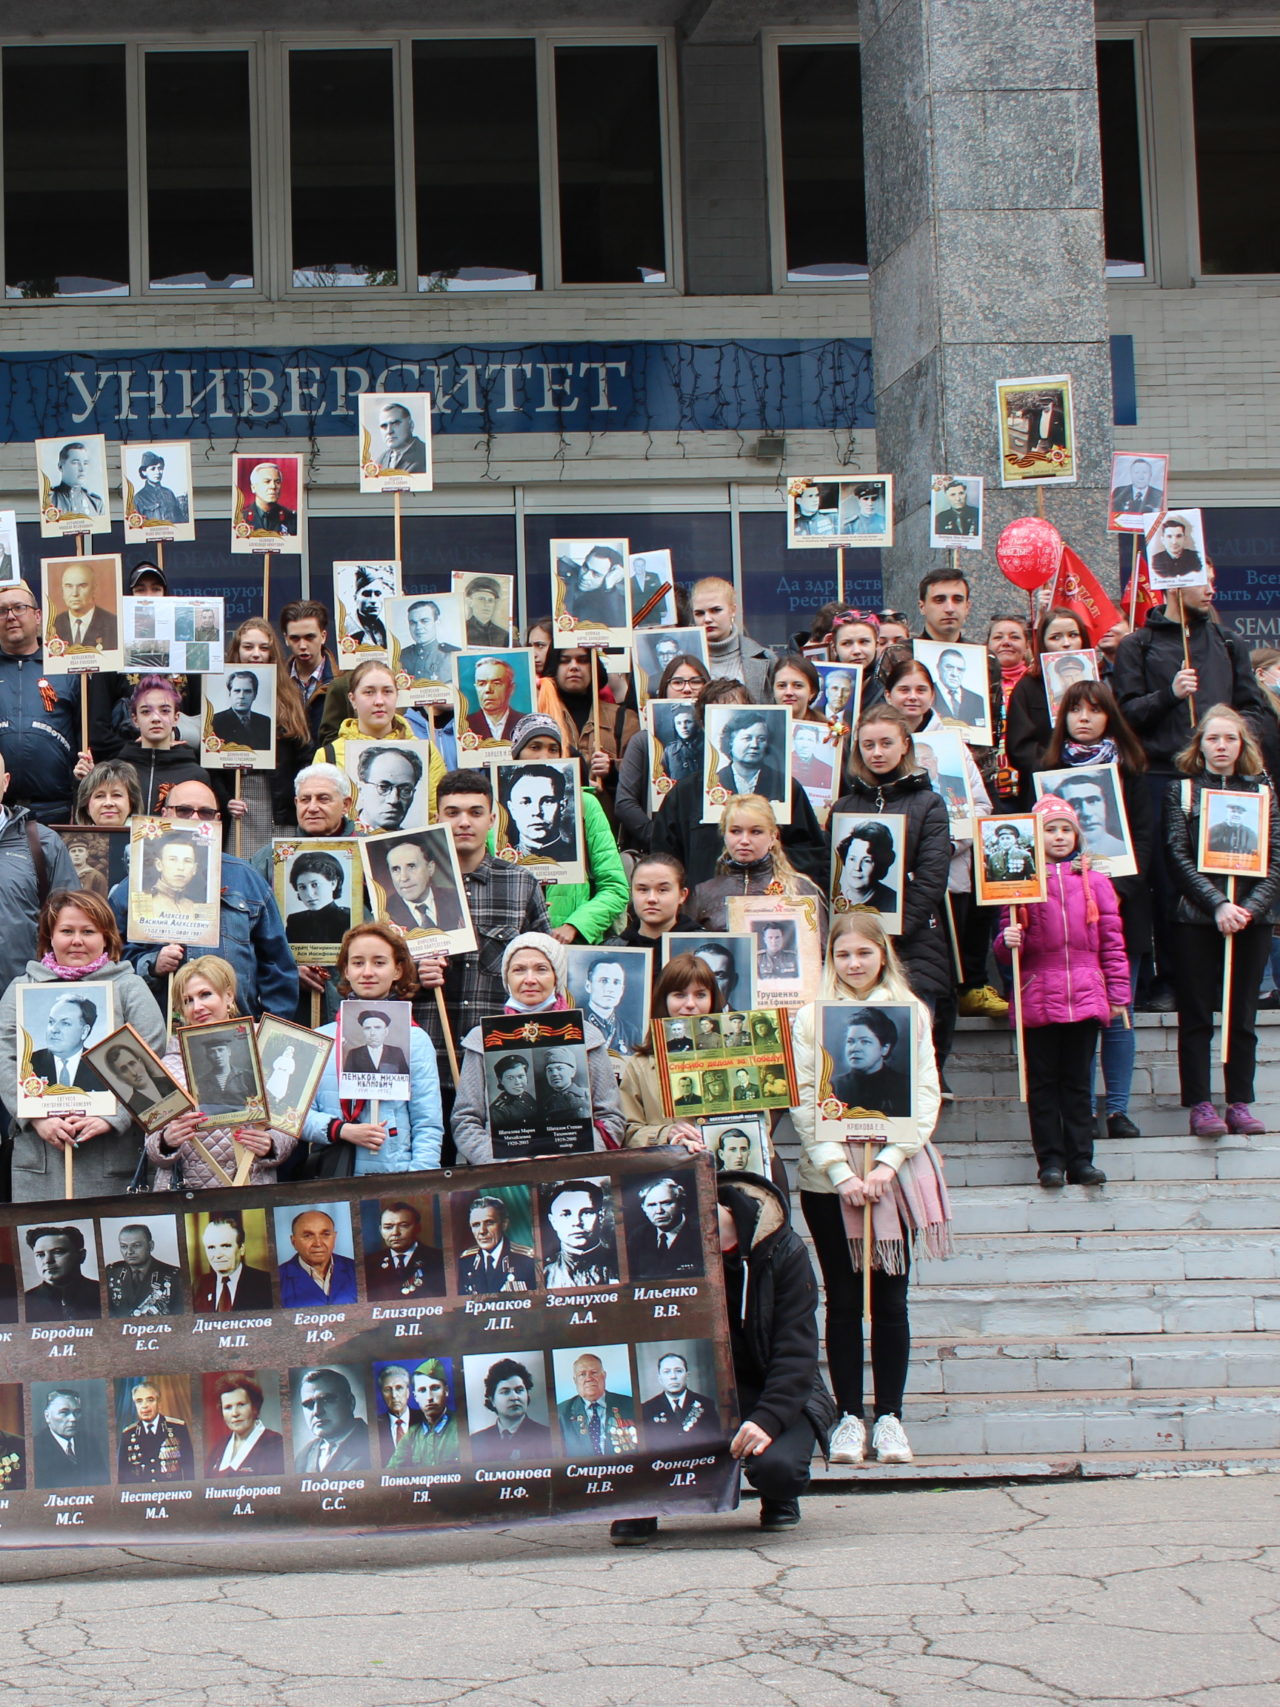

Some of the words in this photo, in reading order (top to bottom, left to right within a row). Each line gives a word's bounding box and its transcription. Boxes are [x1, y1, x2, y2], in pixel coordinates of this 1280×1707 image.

[63, 362, 625, 423] УНИВЕРСИТЕТ
[777, 577, 801, 594] Да
[805, 579, 882, 596] здрвств
[757, 991, 799, 999] Грушенко
[669, 1062, 704, 1072] Спасибо
[707, 1060, 733, 1068] дедам
[634, 1285, 698, 1300] Ильенко
[465, 1298, 532, 1315] Ермаков
[546, 1291, 618, 1310] Земнухов
[372, 1304, 443, 1321] Елизаров
[570, 1311, 597, 1325] А.А.
[653, 1305, 681, 1319] В.В.
[192, 1316, 272, 1334] Диченсков
[294, 1312, 345, 1327] Егоров
[484, 1317, 514, 1331] Л.П.
[31, 1325, 94, 1340] Бородин
[122, 1323, 172, 1338] Горель
[305, 1330, 336, 1343] И.Ф.
[394, 1323, 423, 1337] В.П.
[135, 1339, 160, 1351] Е.С.
[218, 1335, 249, 1349] М.П.
[48, 1344, 77, 1358] А.И.
[652, 1454, 715, 1472] Фонарев
[475, 1466, 552, 1482] Симонова
[566, 1463, 634, 1479] Смирнов
[300, 1478, 365, 1493] Подарев
[380, 1472, 461, 1487] Пономаренко
[670, 1473, 697, 1487] Л.Р.
[205, 1485, 281, 1500] Никифорова
[499, 1486, 529, 1500] Н.Ф.
[586, 1481, 614, 1494] Н.В.
[44, 1493, 94, 1508] Лысак
[120, 1489, 193, 1504] Нестеренко
[321, 1497, 346, 1510] С.С.
[412, 1490, 431, 1503] Г.Я.
[145, 1507, 169, 1519] М.А.
[232, 1503, 255, 1516] А.А.
[56, 1512, 85, 1526] М.С.
